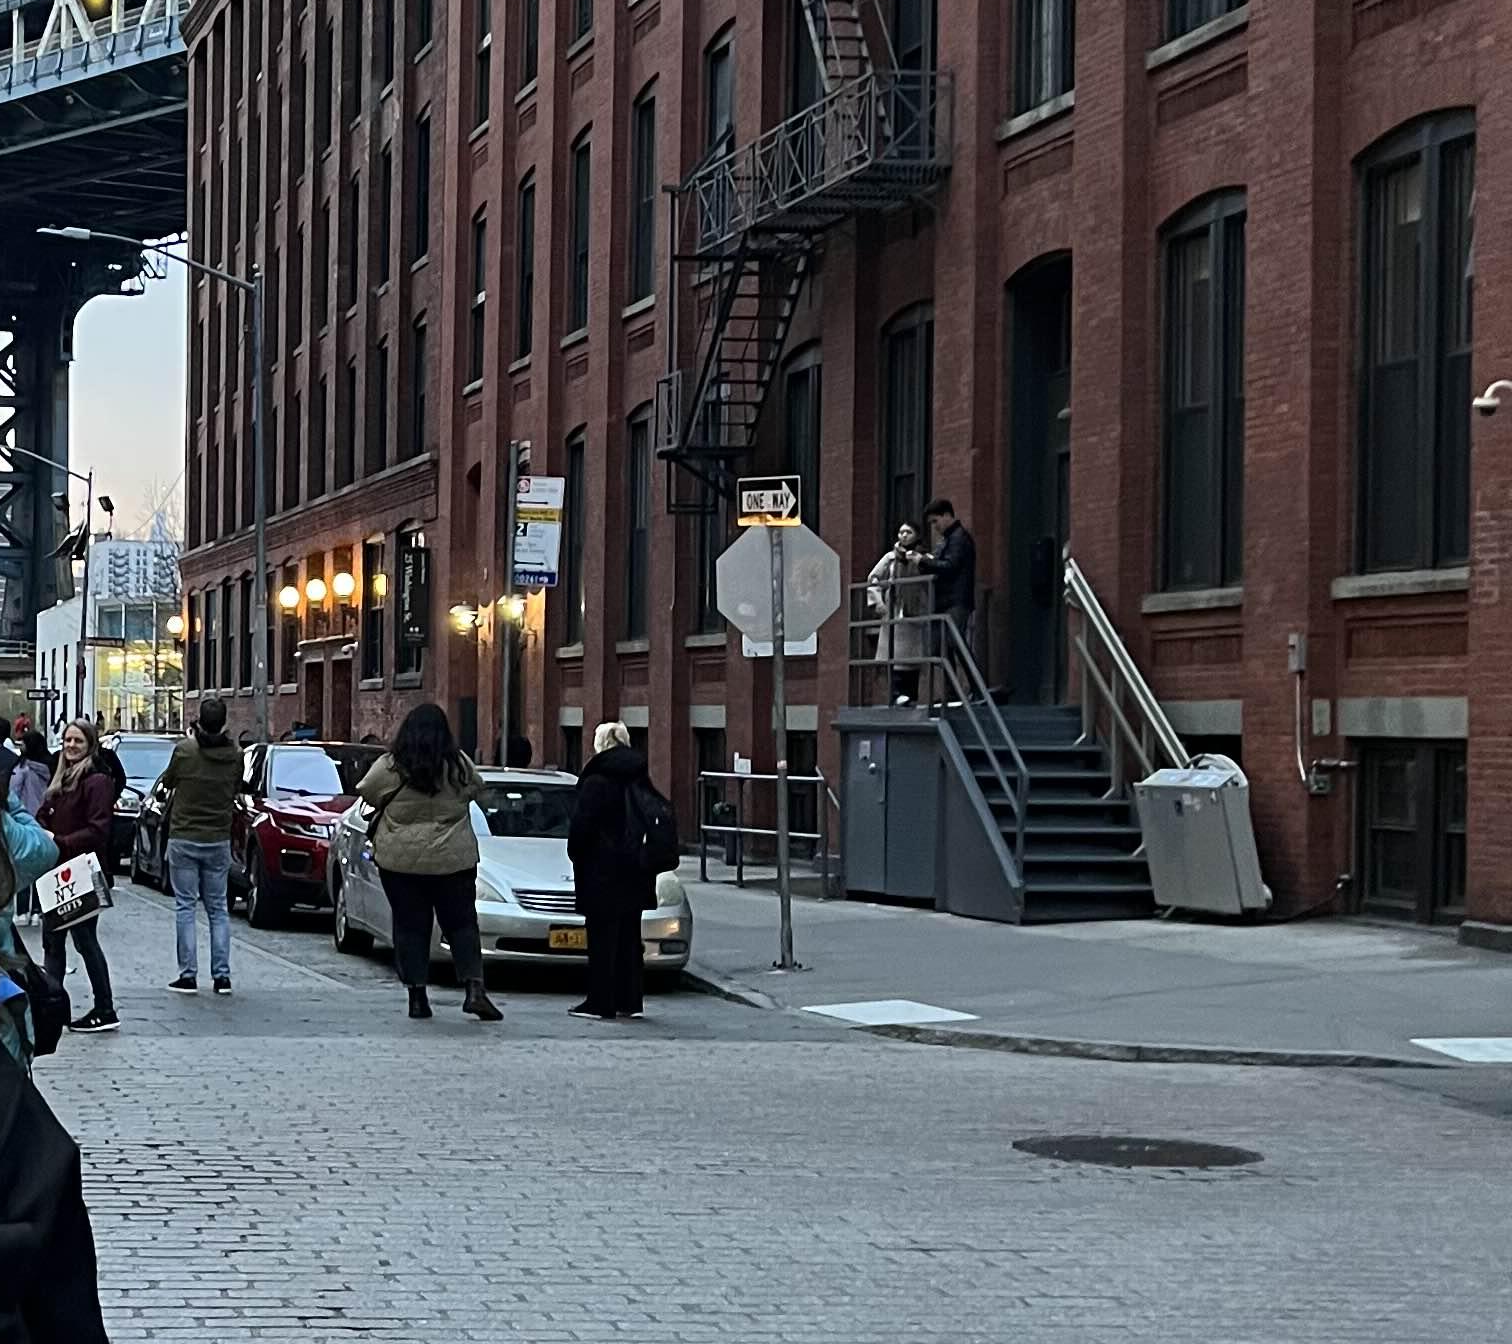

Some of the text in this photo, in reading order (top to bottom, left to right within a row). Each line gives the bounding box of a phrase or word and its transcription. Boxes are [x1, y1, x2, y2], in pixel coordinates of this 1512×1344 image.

[746, 492, 790, 510] ONE WAY
[516, 522, 525, 537] 2
[54, 873, 61, 888] I
[54, 881, 76, 904] NY
[56, 898, 83, 916] GIFTS
